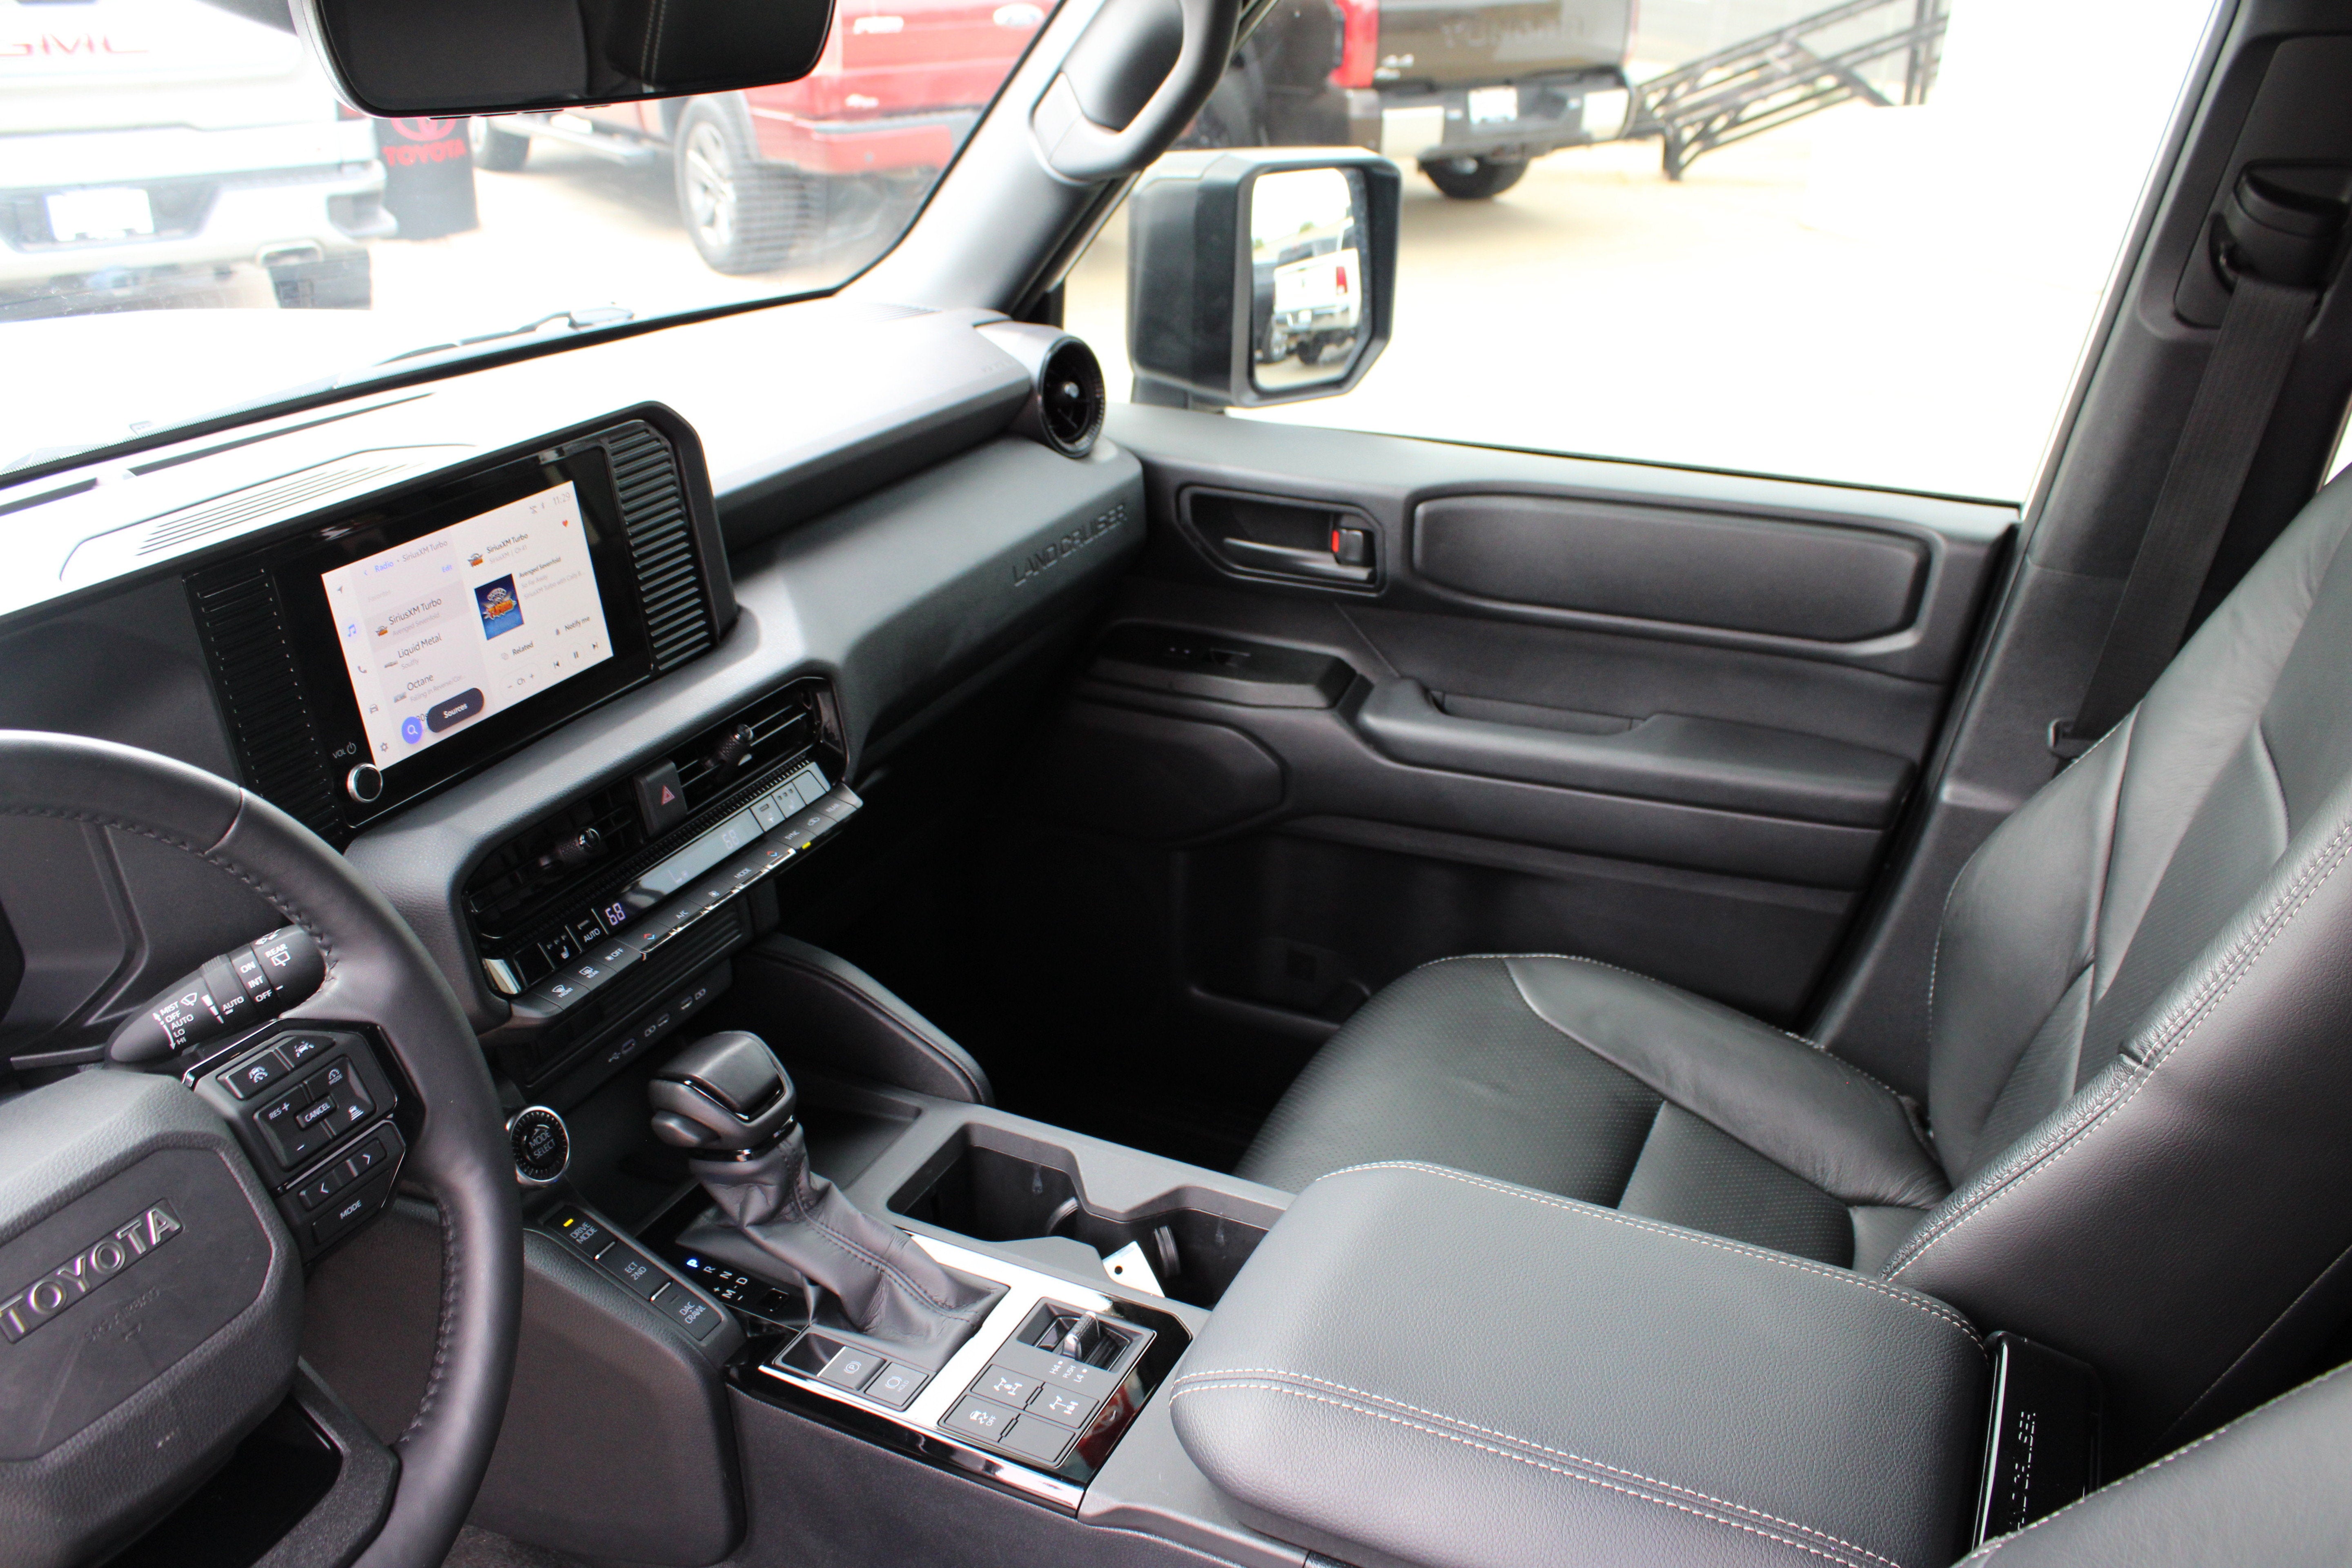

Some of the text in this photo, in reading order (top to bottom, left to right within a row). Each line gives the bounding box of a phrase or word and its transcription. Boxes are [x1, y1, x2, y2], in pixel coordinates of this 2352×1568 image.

[382, 138, 467, 167] TOYOTA
[486, 533, 529, 554] SiriusXM Turbo
[374, 540, 448, 572] Radio SiriusXM Turbo
[441, 564, 453, 572] Edit
[388, 598, 442, 625] SiriusXM Turbo
[564, 616, 591, 631] Notify me
[396, 633, 442, 659] Liquid Metal
[512, 641, 534, 656] Related
[407, 674, 434, 691] Octane
[517, 677, 526, 685] Ch
[442, 703, 468, 719] Sources
[332, 748, 346, 759] VOL
[784, 829, 801, 840] SYNC
[733, 867, 753, 879] MODE
[604, 902, 626, 926] 68
[675, 909, 689, 919] A/C
[583, 927, 601, 942] AUTO
[264, 943, 288, 958] REAR
[611, 947, 624, 958] OFF
[239, 960, 256, 973] ON
[247, 975, 264, 989] INT
[222, 996, 245, 1011] AUTO
[254, 989, 272, 1003] OFF
[158, 1001, 179, 1016] MIST
[165, 1009, 181, 1023] OFF
[171, 1013, 194, 1030] AUTO
[172, 1028, 186, 1038] LO
[175, 1036, 187, 1045] HI
[327, 1073, 343, 1086] MODE
[268, 1107, 282, 1120] RES
[304, 1102, 331, 1123] CANCEL
[529, 1129, 551, 1149] MODE
[533, 1138, 556, 1159] SELECT
[339, 1200, 362, 1220] MODE
[570, 1221, 591, 1239] DRIVE
[576, 1226, 598, 1244] MODE
[0, 1207, 181, 1334] TOYOTA
[624, 1261, 638, 1274] ECT
[630, 1266, 647, 1281] 2ND
[686, 1258, 698, 1268] P
[719, 1271, 733, 1280] N
[735, 1277, 748, 1285] D
[721, 1289, 736, 1299] M
[679, 1301, 695, 1316] DAC
[684, 1305, 706, 1324] CRAWL
[1049, 1363, 1062, 1375] H4
[1062, 1364, 1076, 1379] PUSH
[1073, 1373, 1085, 1383] L4
[897, 1380, 909, 1392] HOLD
[985, 1414, 997, 1427] OFF
